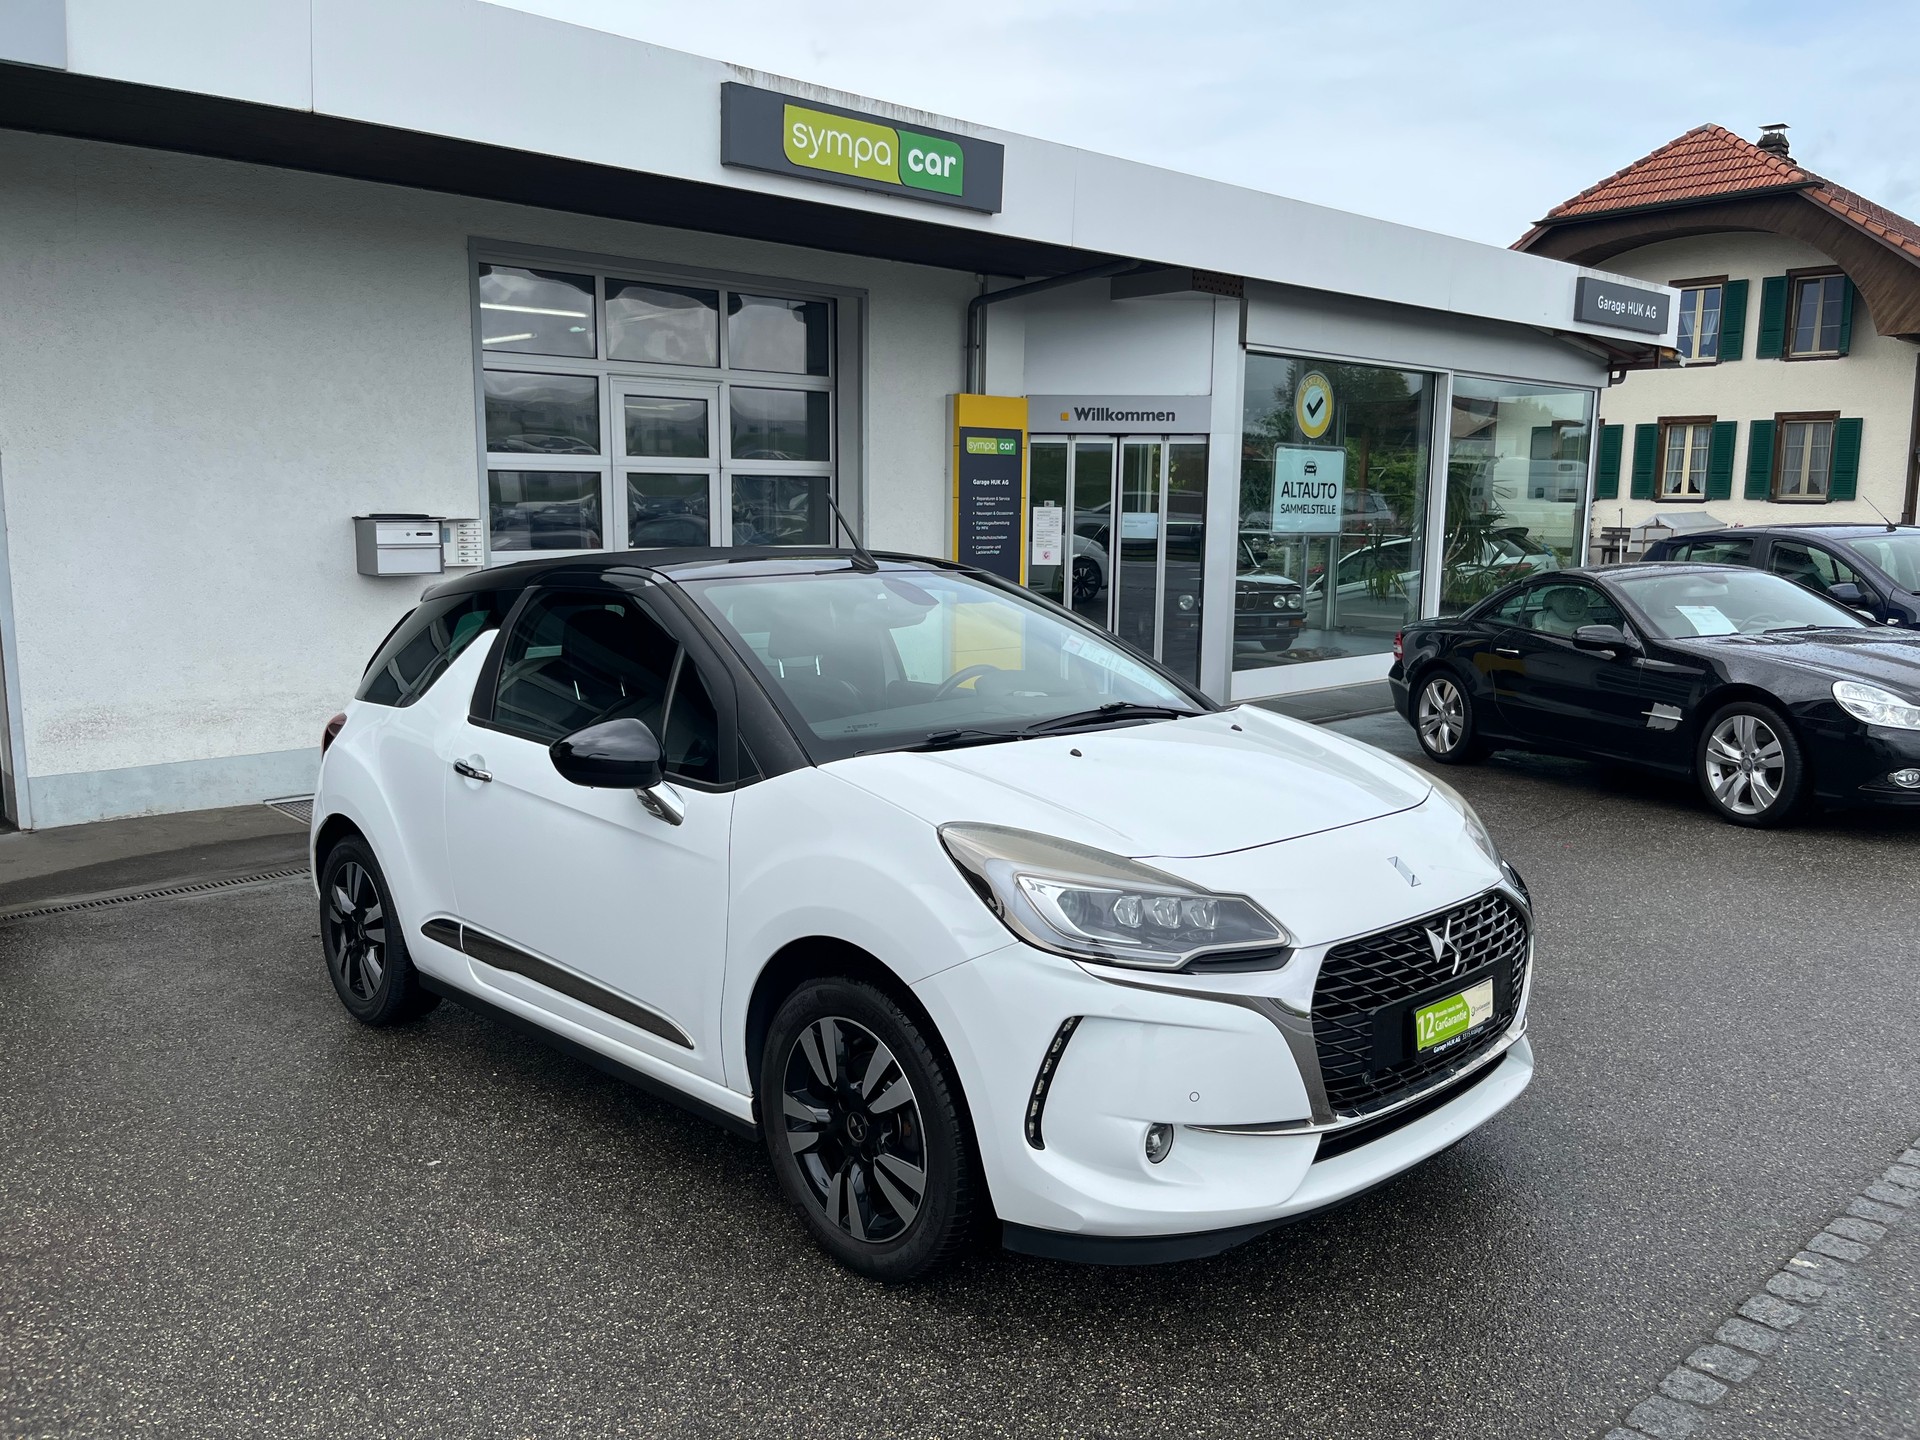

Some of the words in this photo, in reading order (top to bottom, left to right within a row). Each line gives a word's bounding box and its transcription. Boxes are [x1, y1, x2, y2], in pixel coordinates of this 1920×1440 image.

[792, 122, 891, 168] sympa
[908, 149, 957, 178] car
[1597, 295, 1626, 314] Garage
[1627, 302, 1644, 316] HUK
[1644, 305, 1656, 319] AG
[1074, 407, 1176, 422] Willkommen
[968, 442, 996, 452] sympa
[1000, 442, 1014, 450] car
[1280, 482, 1337, 499] ALTAUTO
[1280, 503, 1336, 514] SAMMELSTELLE
[1418, 1012, 1435, 1042] 12
[1435, 1008, 1467, 1031] CarGarantie
[1433, 1043, 1447, 1054] Garage
